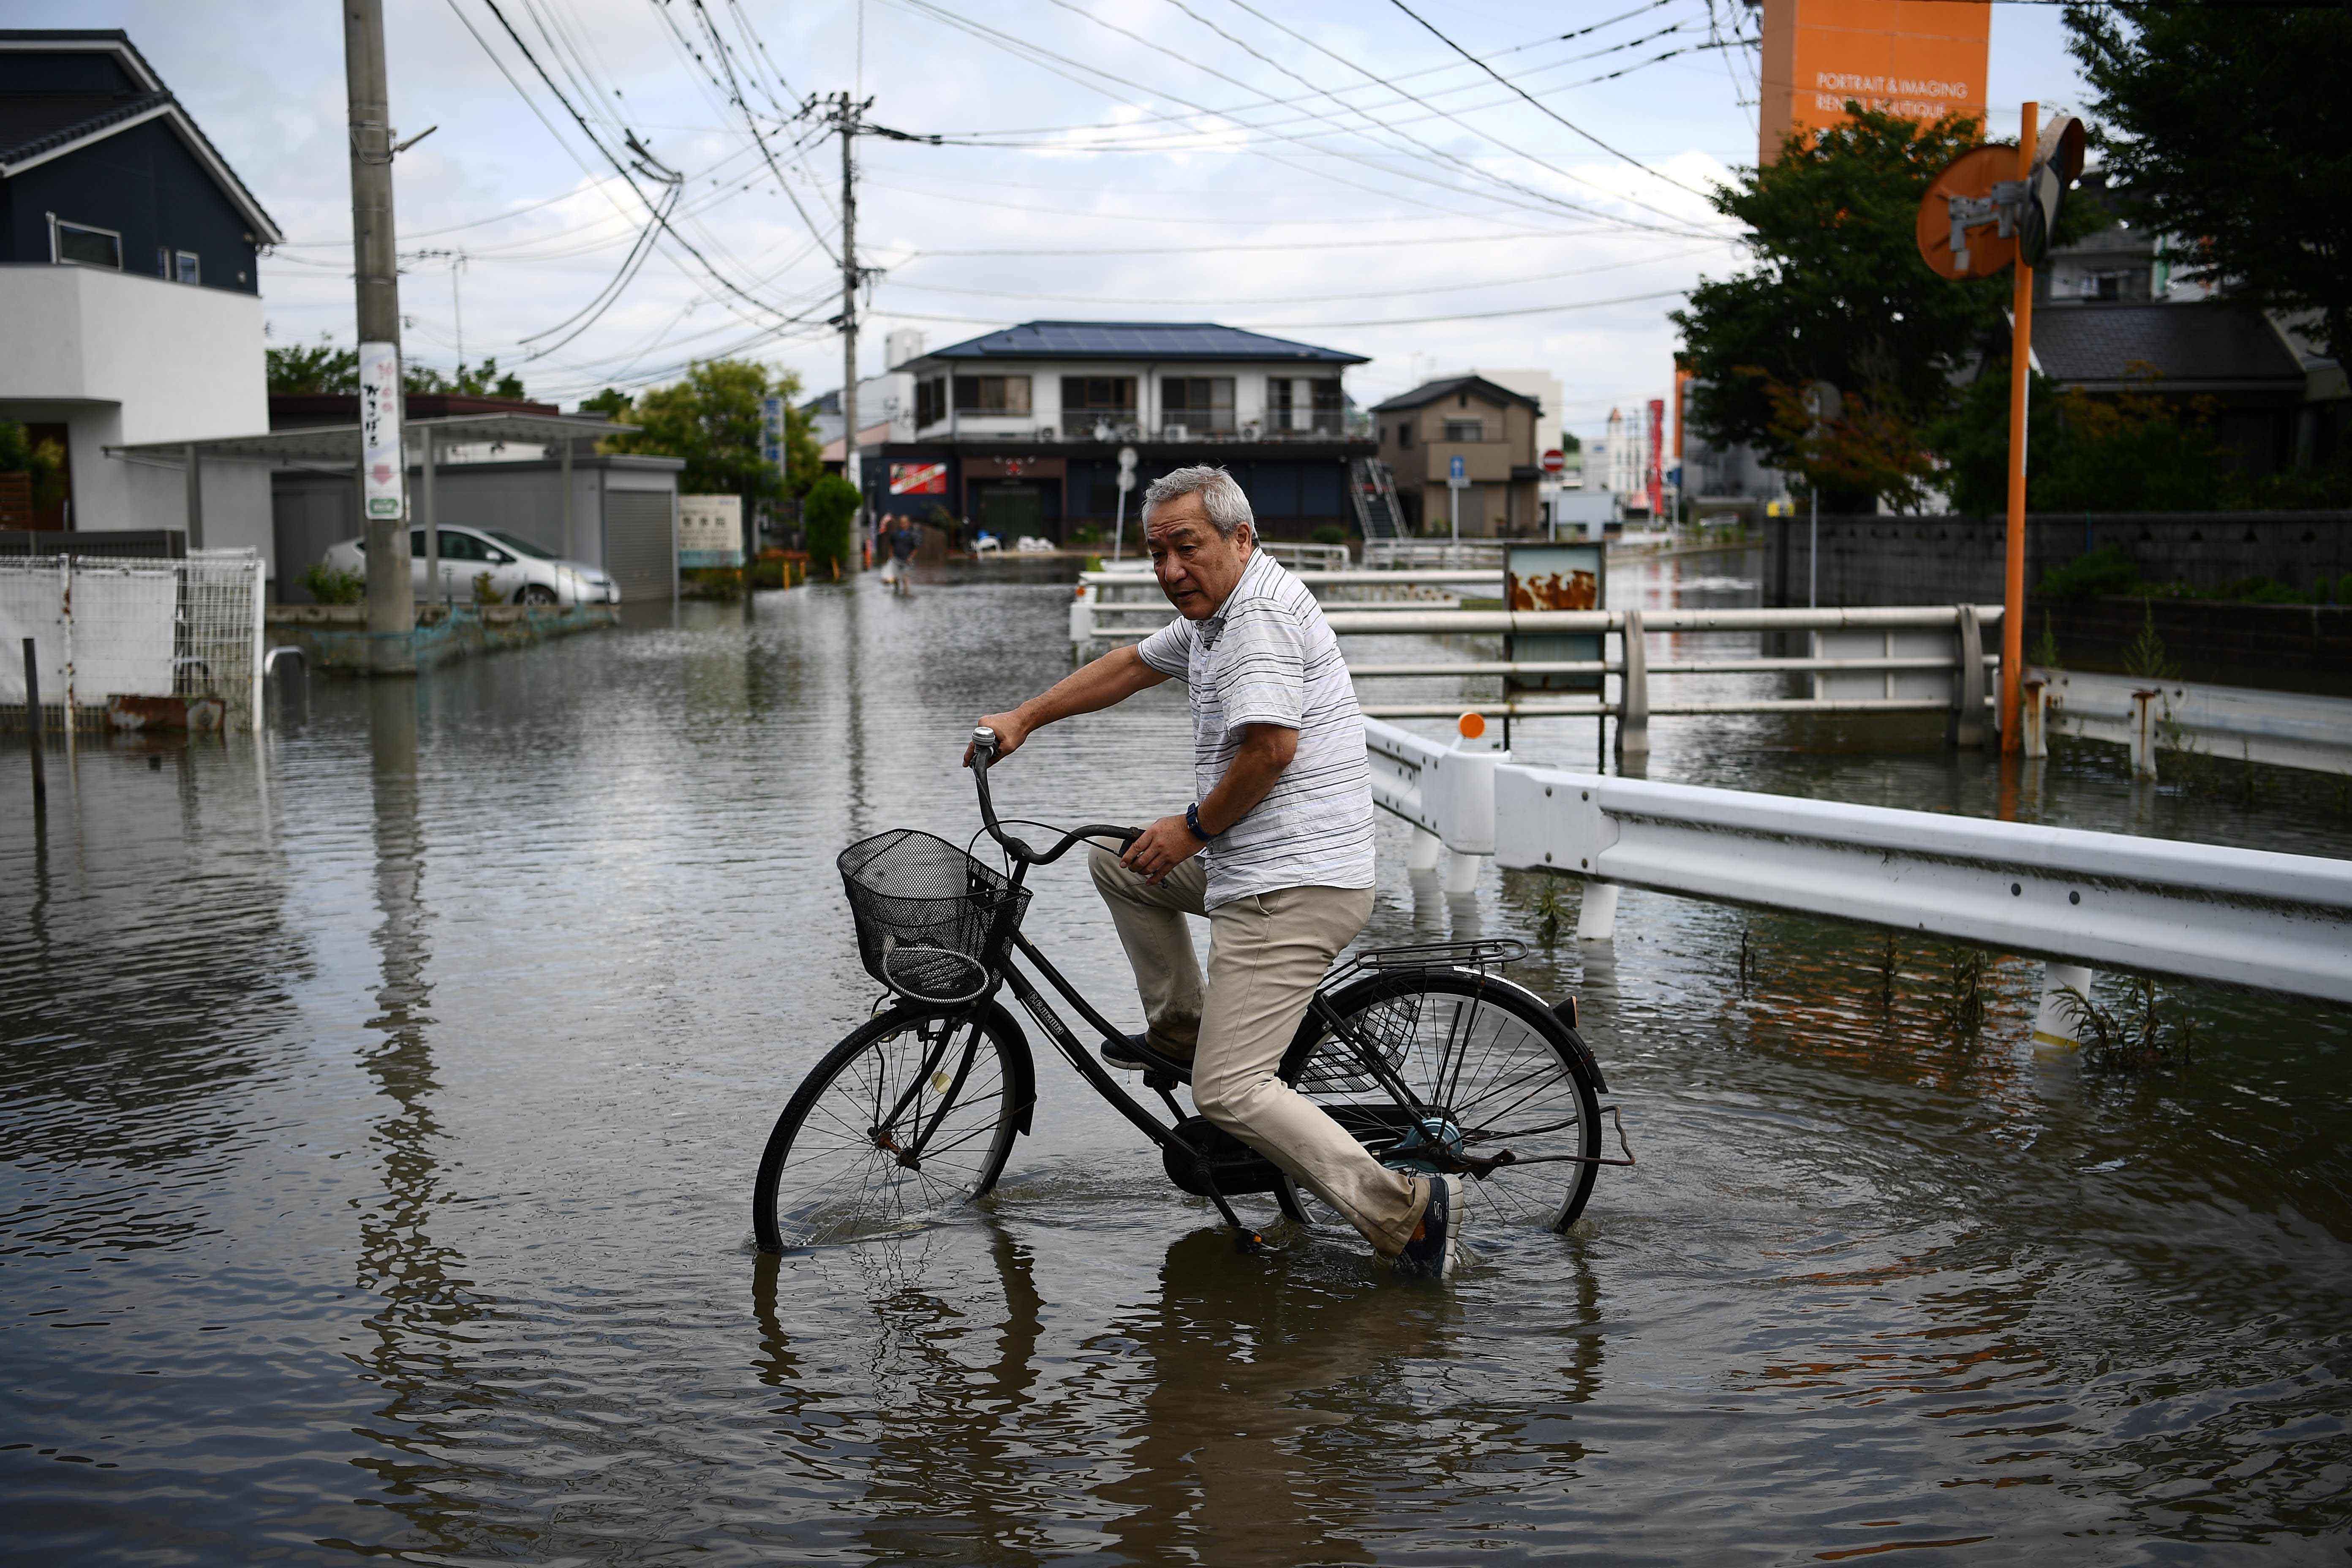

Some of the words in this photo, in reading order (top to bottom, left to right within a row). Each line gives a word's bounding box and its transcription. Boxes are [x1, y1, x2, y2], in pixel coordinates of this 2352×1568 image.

[1816, 72, 1884, 92] PORTRAIT
[1886, 77, 1898, 94] &
[1899, 79, 1968, 99] IMAGING
